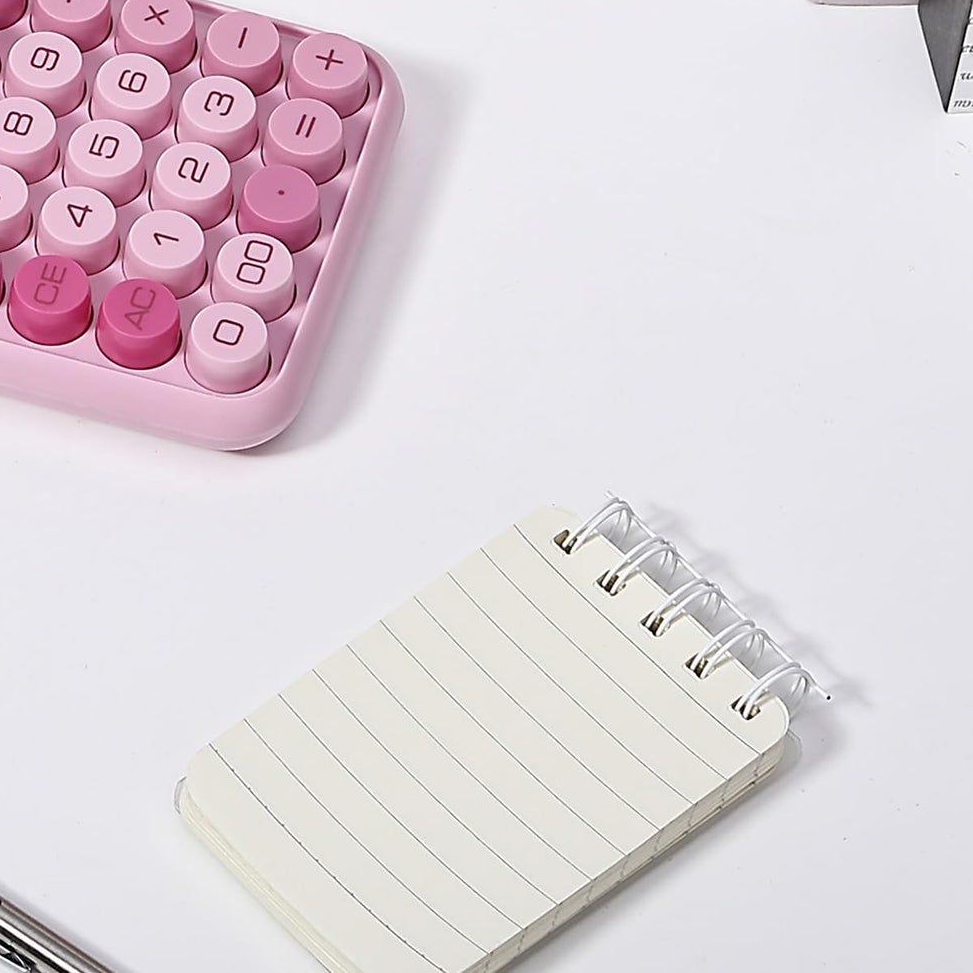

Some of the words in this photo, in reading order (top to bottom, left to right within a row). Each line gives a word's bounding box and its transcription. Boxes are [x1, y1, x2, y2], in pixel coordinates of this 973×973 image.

[30, 46, 60, 71] 9
[118, 69, 148, 94] 6
[204, 90, 235, 116] 3
[3, 111, 34, 136] 8
[89, 134, 120, 159] 5
[178, 157, 209, 183] 2
[67, 203, 93, 227] 4
[153, 231, 180, 246] 1
[236, 238, 274, 286] 00
[33, 262, 68, 306] CE
[123, 286, 157, 331] AC
[213, 319, 244, 346] 0
